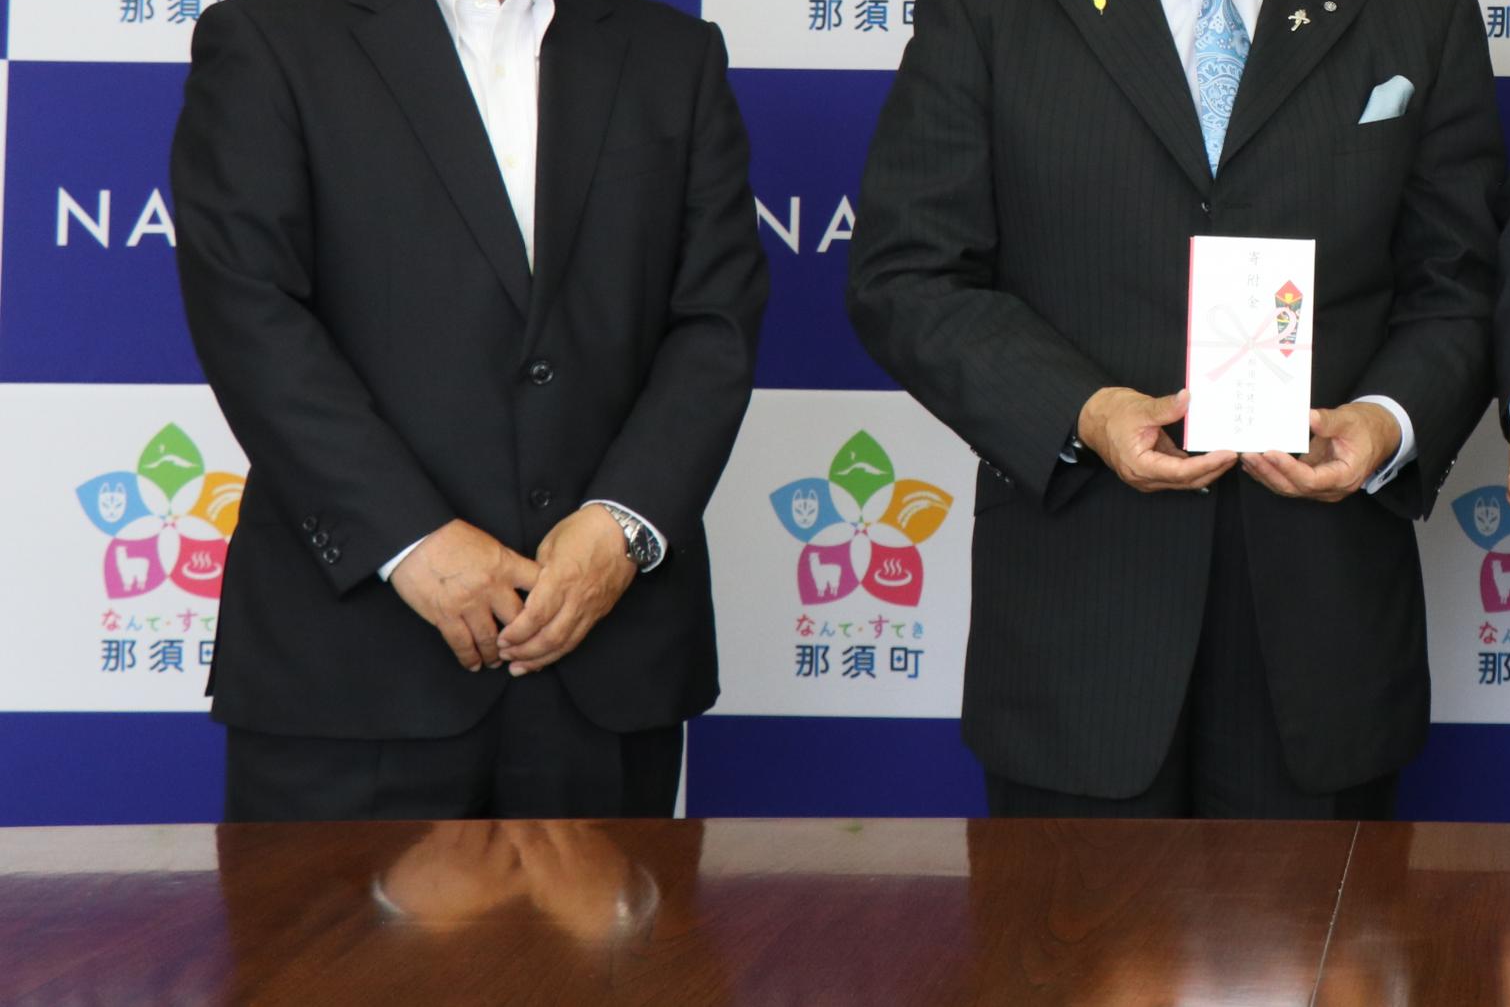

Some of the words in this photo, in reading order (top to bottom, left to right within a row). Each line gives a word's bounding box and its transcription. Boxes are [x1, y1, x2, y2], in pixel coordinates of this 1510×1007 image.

[56, 187, 177, 249] NA
[754, 195, 857, 255] NA
[103, 610, 214, 632] なんて・すて
[795, 645, 925, 679] 那須町
